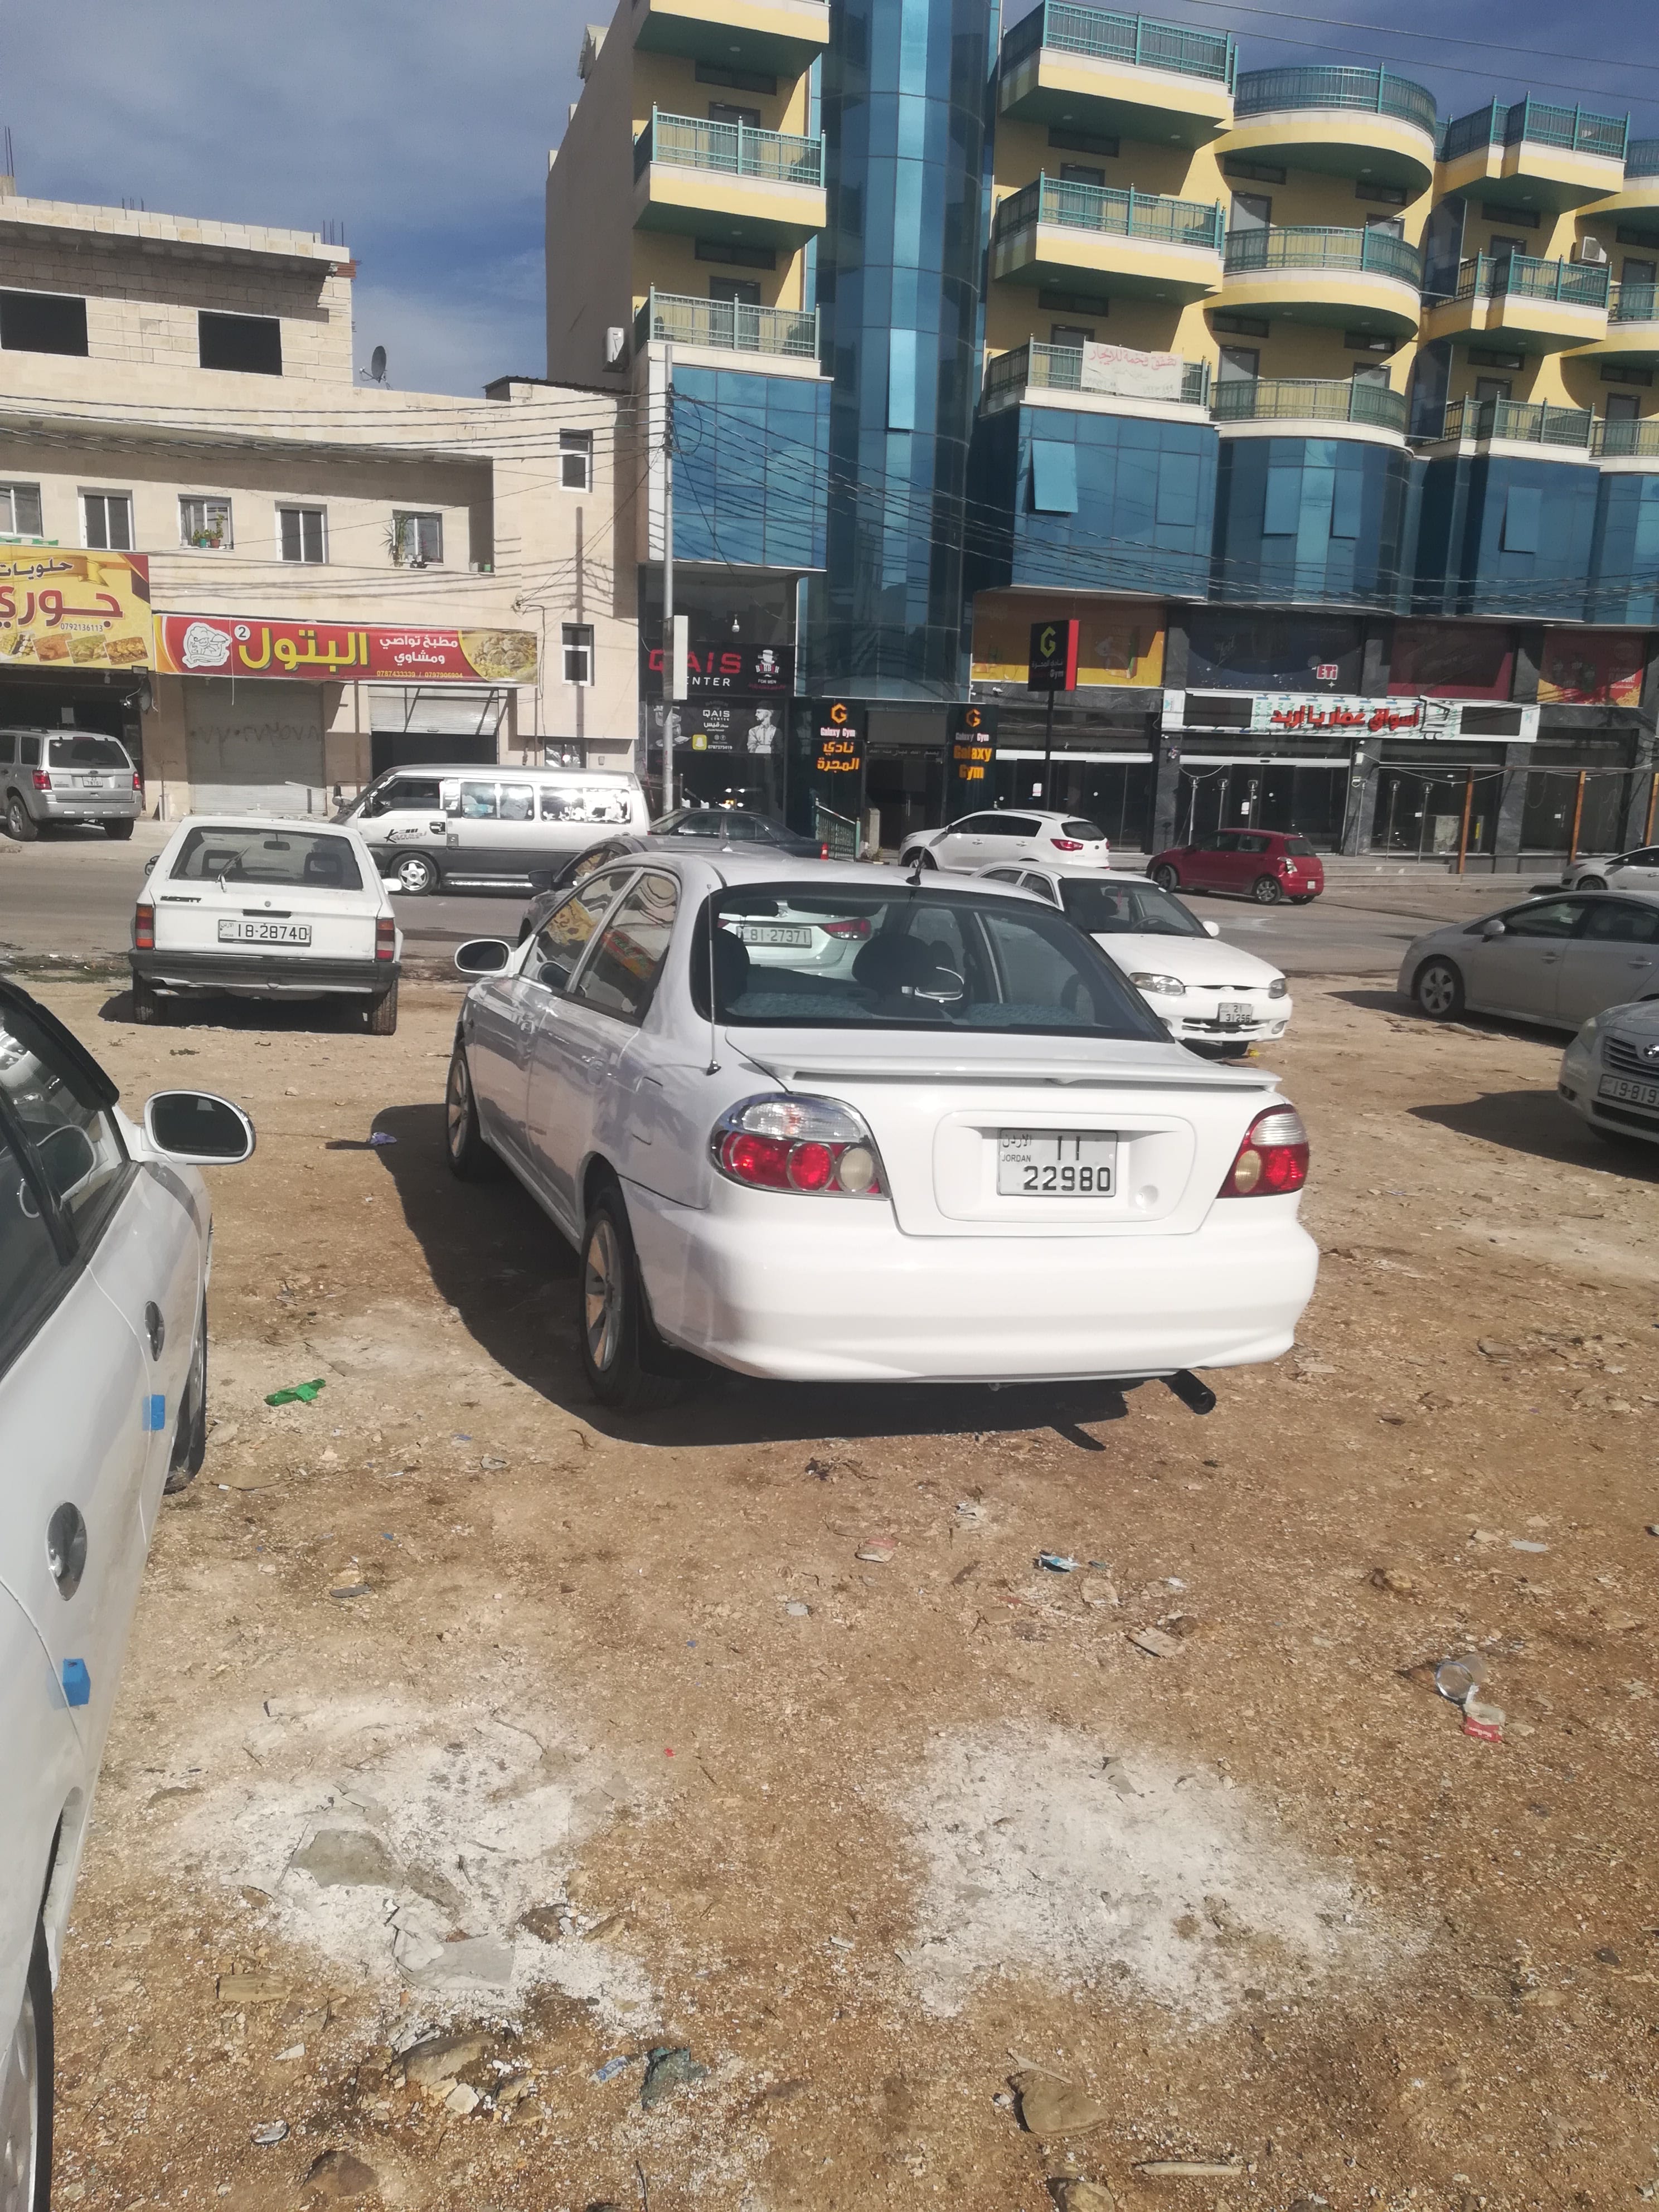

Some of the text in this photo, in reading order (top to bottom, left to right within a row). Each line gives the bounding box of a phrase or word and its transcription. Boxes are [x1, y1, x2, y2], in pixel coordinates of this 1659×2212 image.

[0, 558, 73, 580] حلويات
[0, 586, 124, 628] جوري
[61, 623, 103, 632] 0792136113
[239, 627, 246, 638] 2
[239, 628, 368, 672] البتول
[380, 635, 458, 649] مطبخ تواصي
[394, 650, 445, 666] ومشاوي
[1317, 664, 1338, 680] ETi
[703, 710, 730, 718] QAIS
[820, 727, 856, 738] Galaxy Gym
[955, 732, 989, 743] Galaxy Gym
[823, 741, 854, 756] نادي
[953, 745, 992, 762] Galaxy
[817, 757, 860, 774] المجرة
[959, 764, 984, 780] Gym
[1613, 1081, 1659, 1106] 19-819
[1001, 1154, 1031, 1162] JORDAN
[1023, 1165, 1111, 1192] 22980
